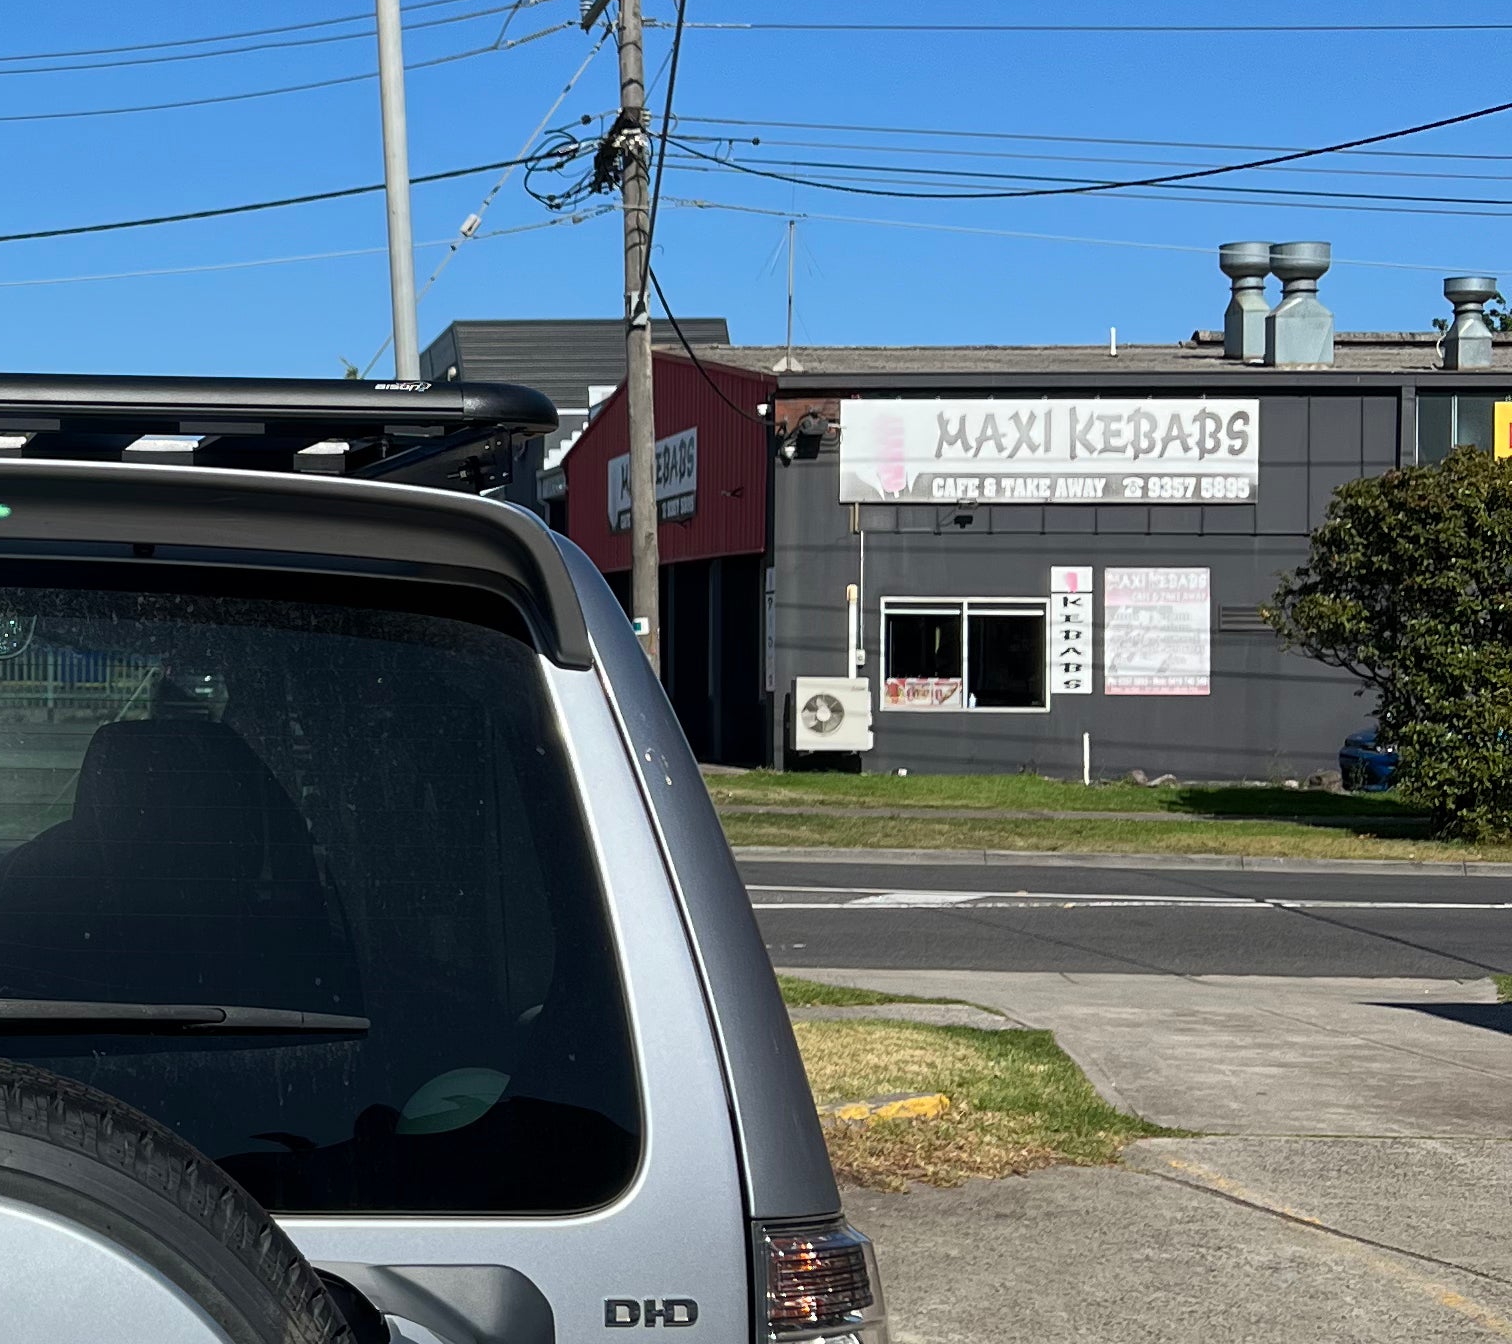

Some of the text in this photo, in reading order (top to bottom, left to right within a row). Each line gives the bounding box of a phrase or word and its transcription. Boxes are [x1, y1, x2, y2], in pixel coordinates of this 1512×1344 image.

[934, 406, 1251, 462] MAXI KEBABS
[655, 435, 696, 489] EBABS
[932, 475, 1251, 499] CAFE & TAKE AWAY 9357 5895
